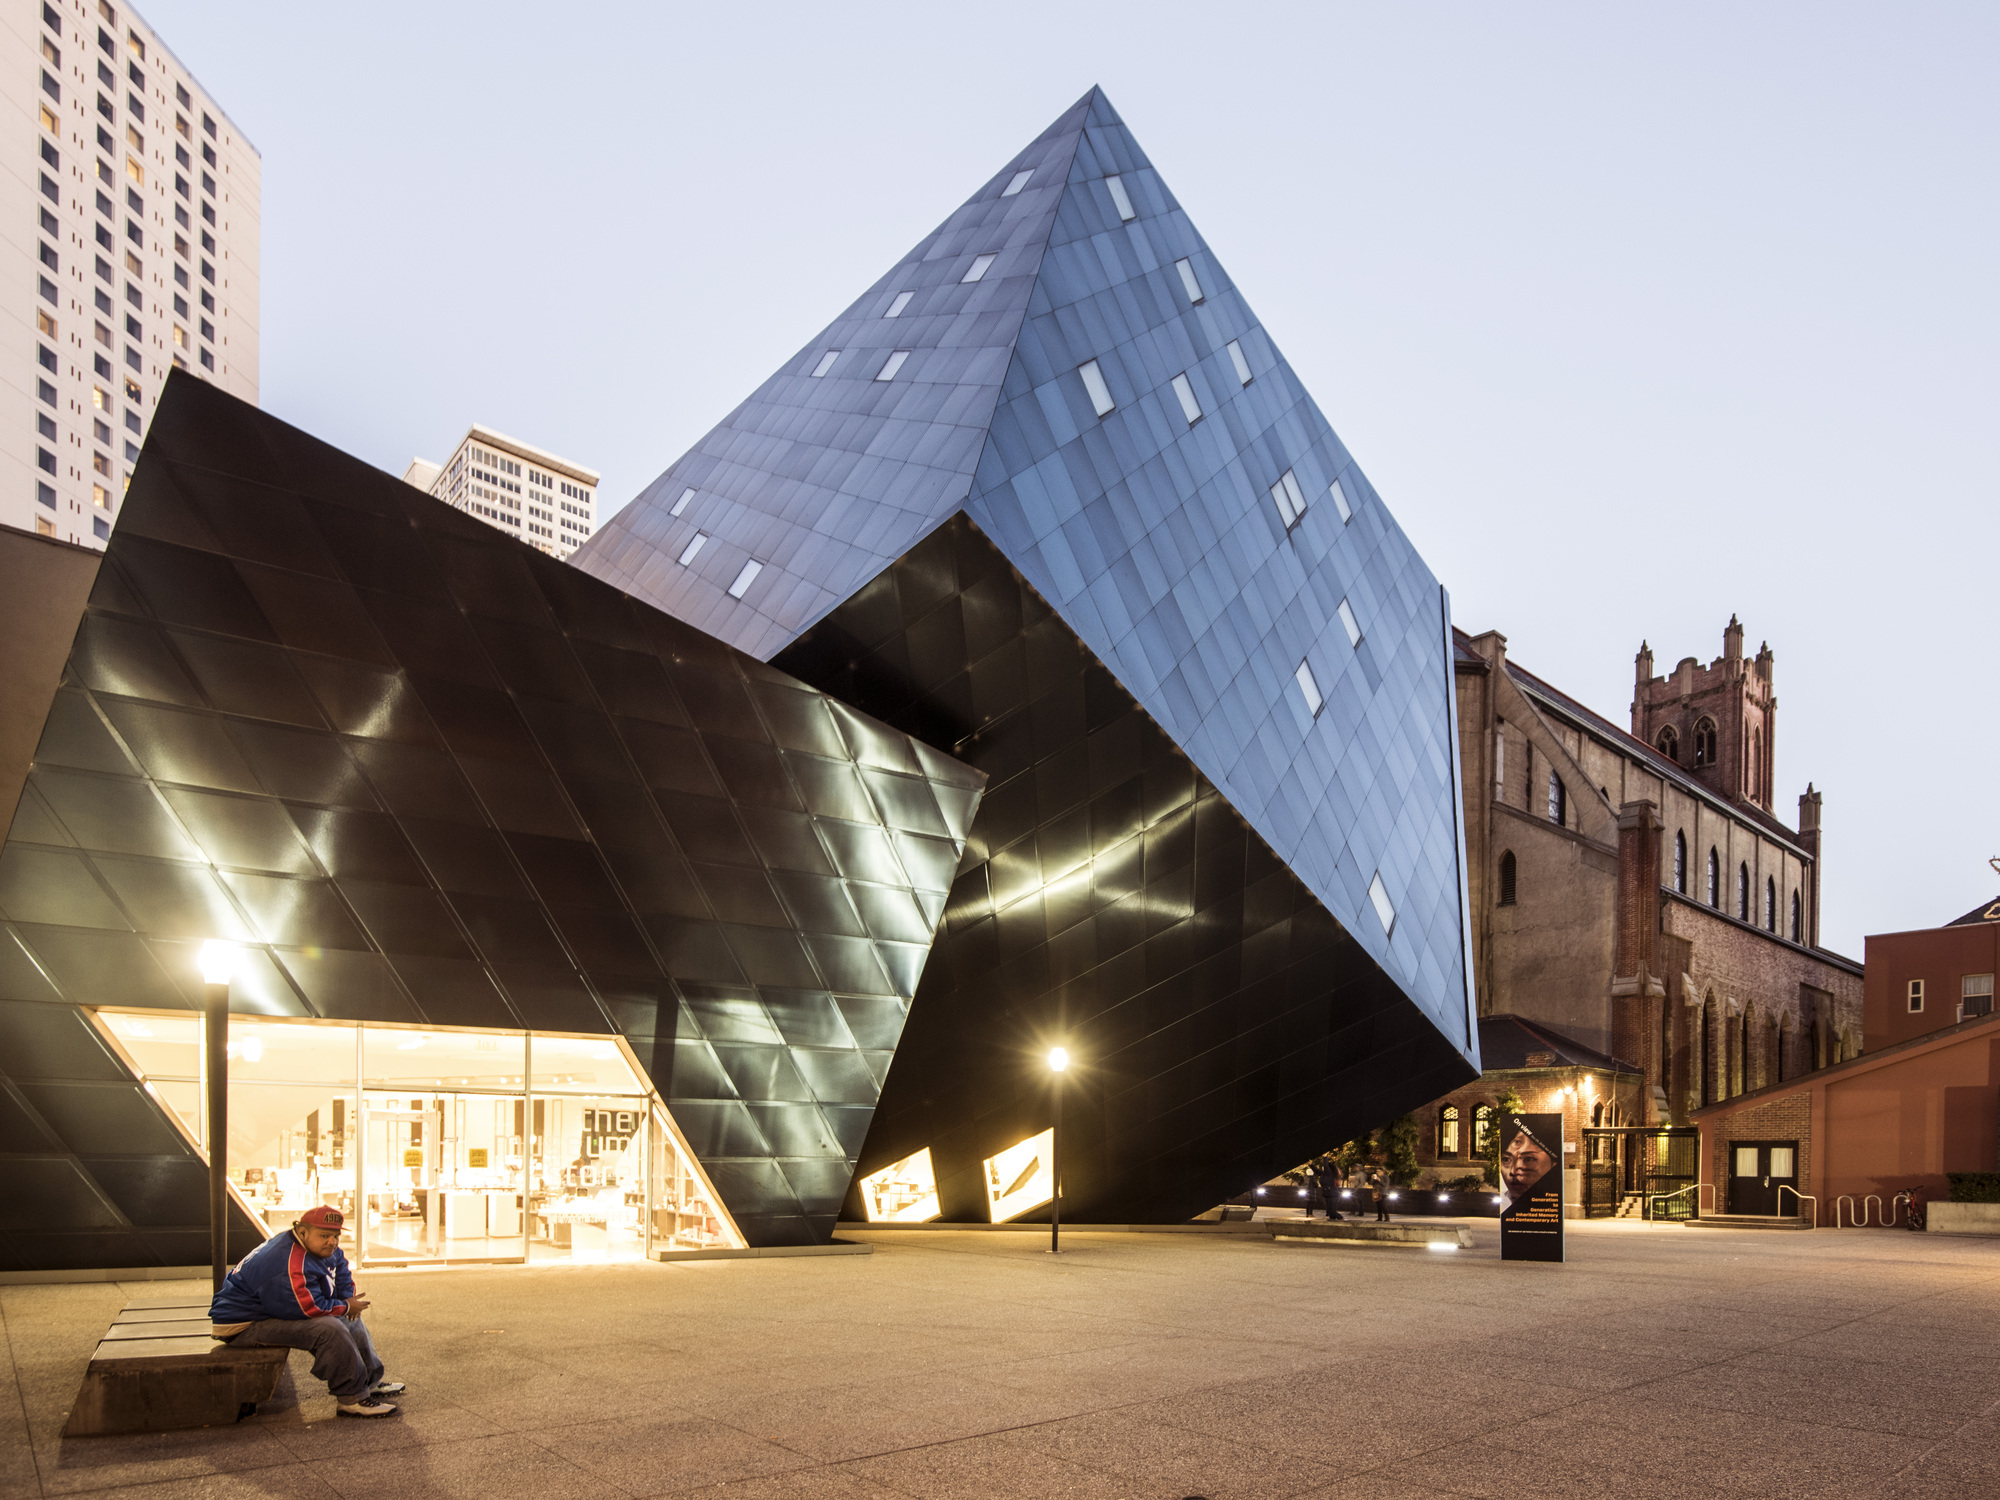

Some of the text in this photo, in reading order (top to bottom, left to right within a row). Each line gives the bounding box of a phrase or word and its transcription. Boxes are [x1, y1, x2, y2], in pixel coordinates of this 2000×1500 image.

[581, 1103, 632, 1133] the
[1514, 1118, 1532, 1135] On view
[547, 1160, 632, 1187] store
